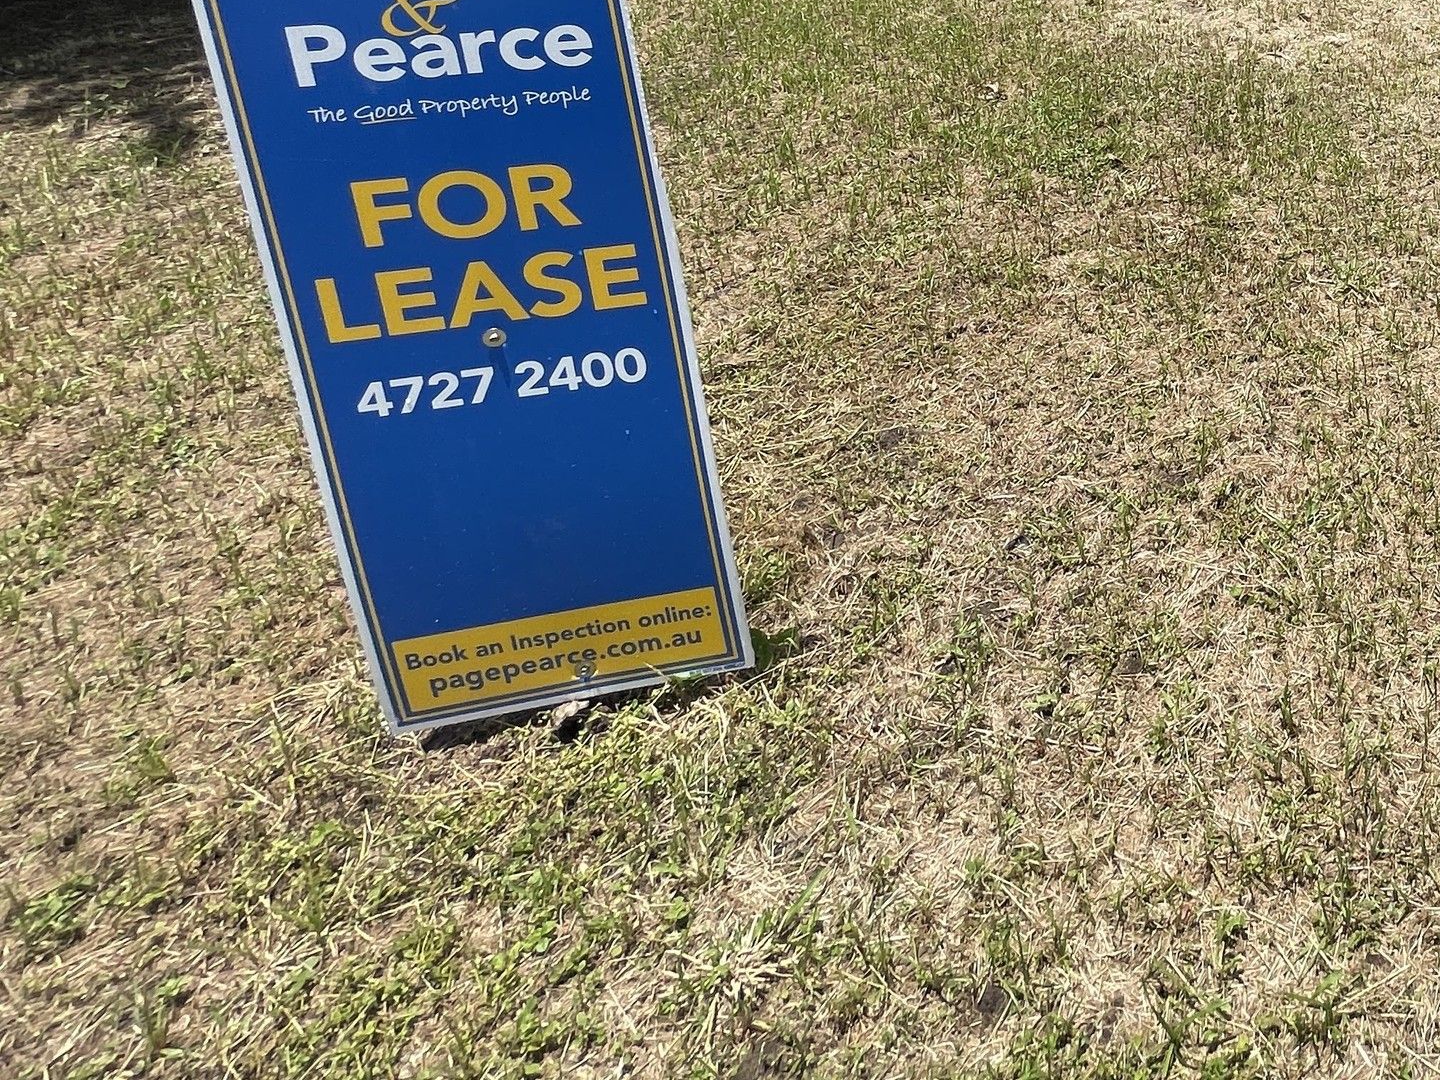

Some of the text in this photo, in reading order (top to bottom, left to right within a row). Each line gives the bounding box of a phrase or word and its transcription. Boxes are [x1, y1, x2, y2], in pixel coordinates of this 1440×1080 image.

[284, 23, 594, 88] Pearce
[307, 85, 592, 125] The Good Property People
[349, 163, 582, 248] FOR
[314, 243, 649, 344] LEASE
[356, 347, 648, 418] 4727 2400
[404, 603, 713, 672] Book an Inspection online:
[429, 629, 703, 698] pagepearce.com.au
